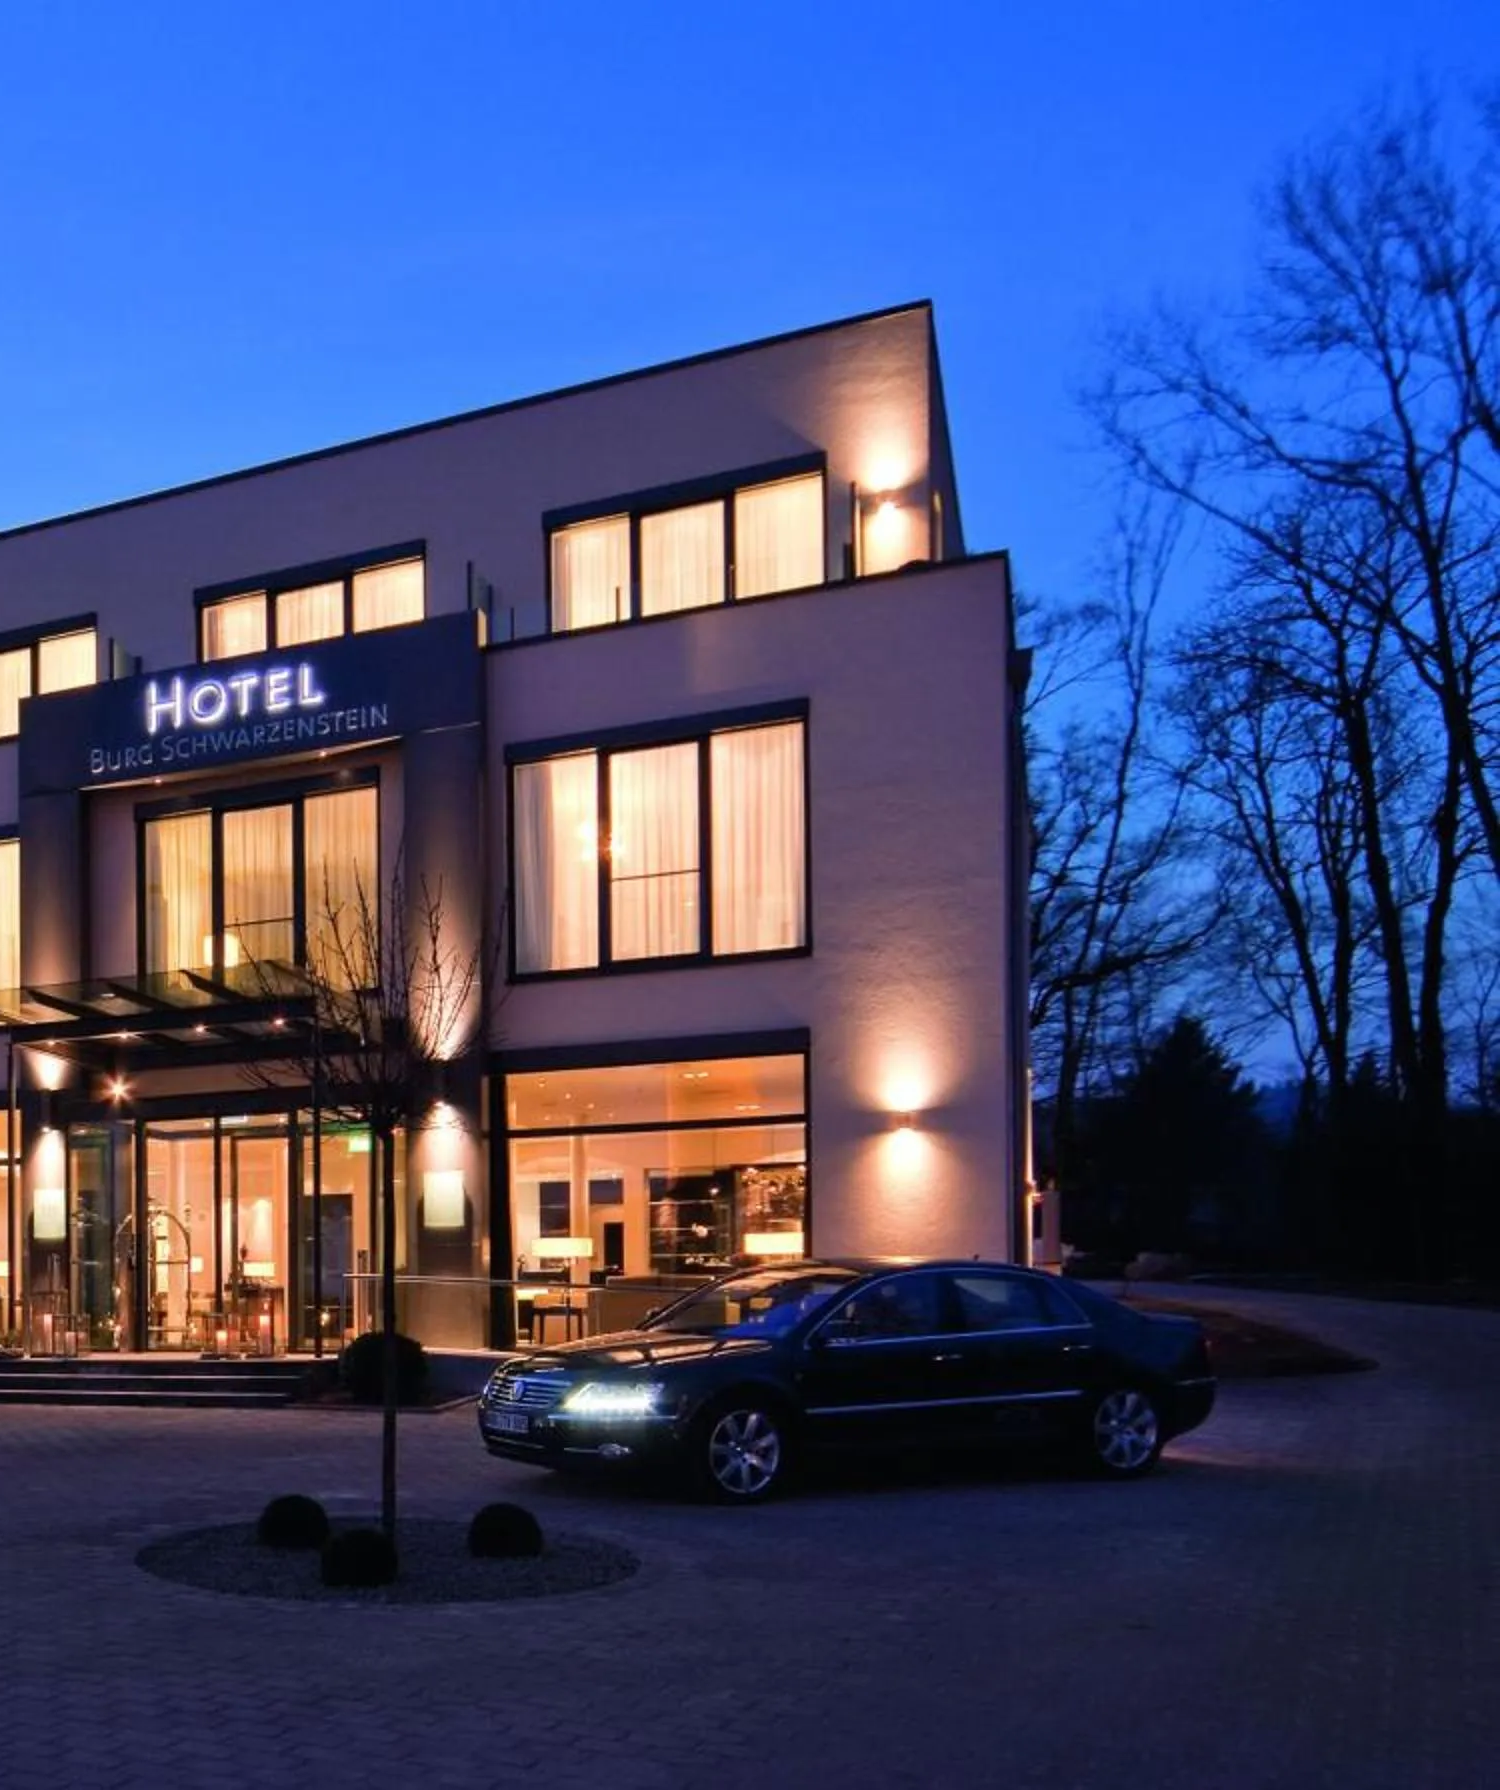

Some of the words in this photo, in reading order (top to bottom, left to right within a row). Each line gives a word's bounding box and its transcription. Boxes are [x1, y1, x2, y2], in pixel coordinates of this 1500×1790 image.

[145, 663, 324, 733] HOTEL
[91, 744, 153, 774] BURG
[161, 705, 389, 762] SCHWARZENSTEIN
